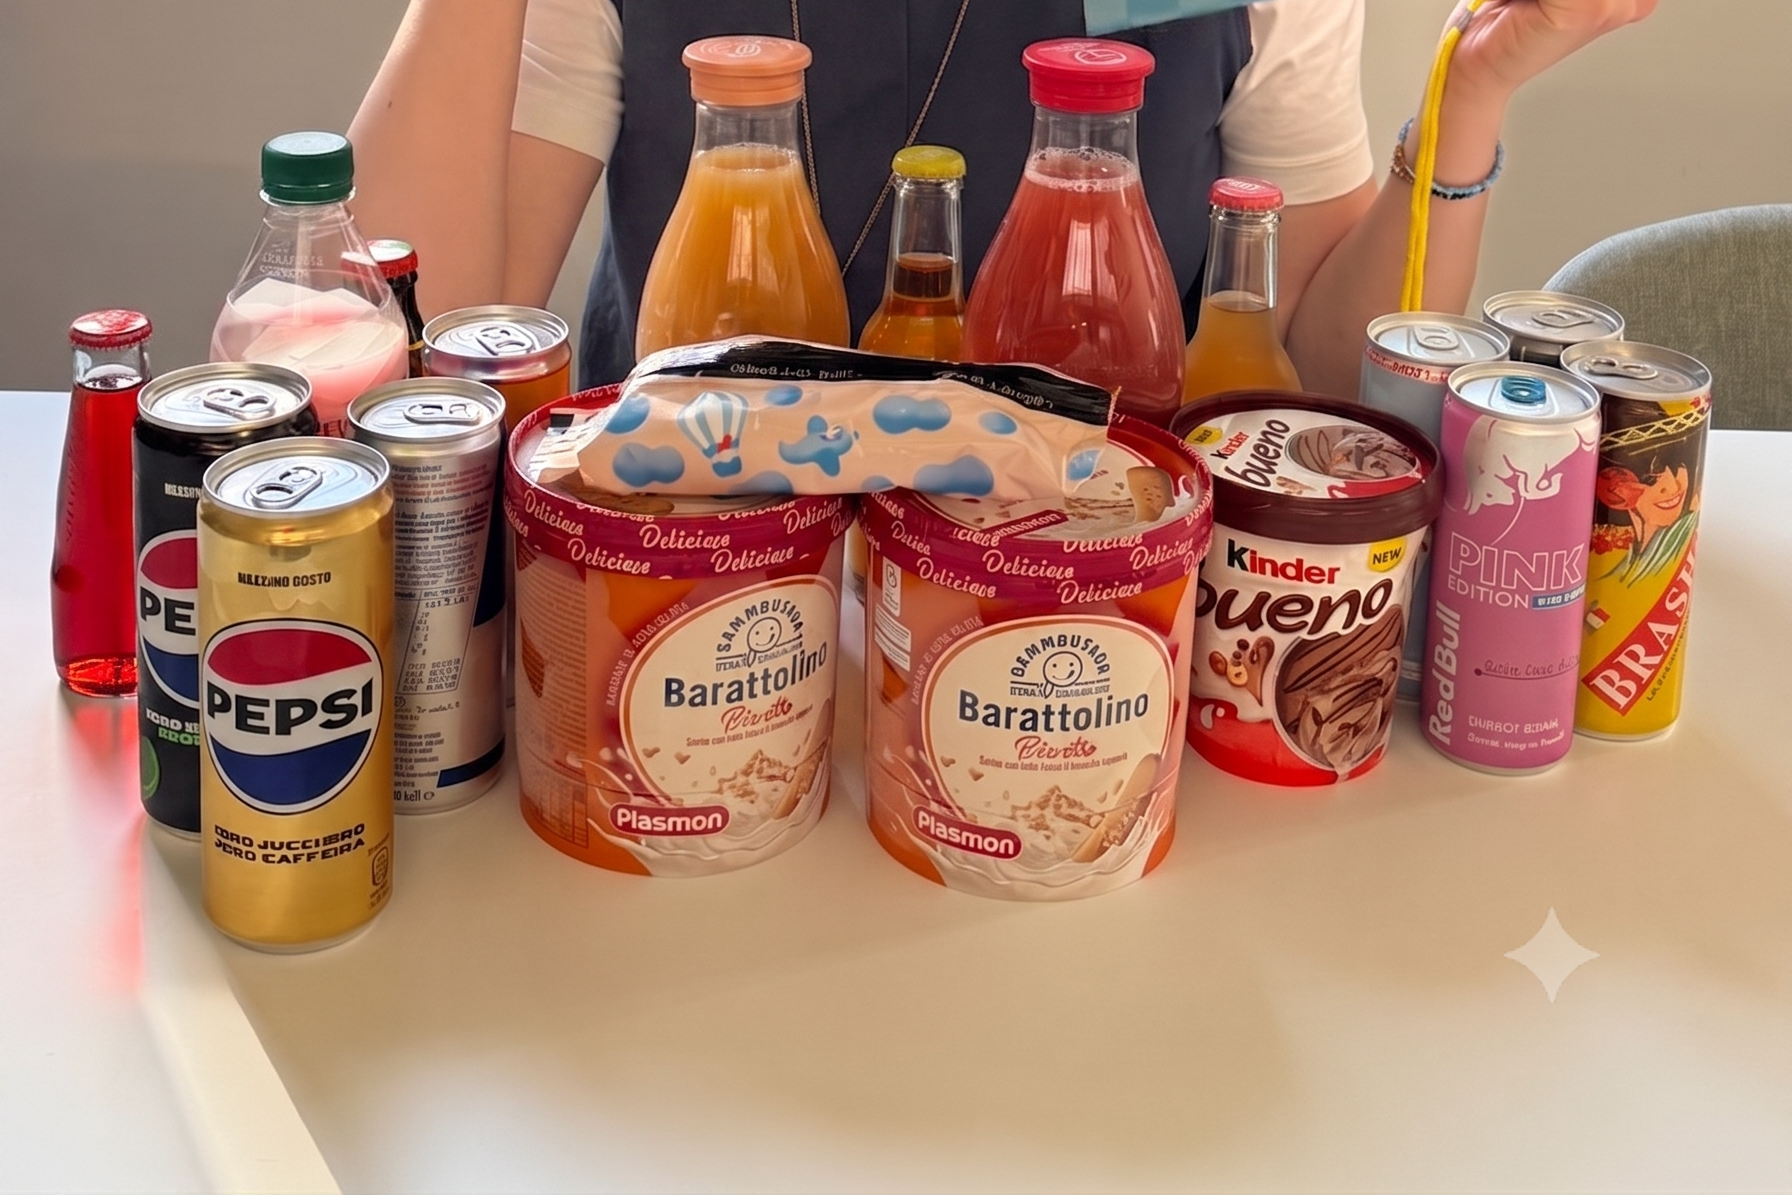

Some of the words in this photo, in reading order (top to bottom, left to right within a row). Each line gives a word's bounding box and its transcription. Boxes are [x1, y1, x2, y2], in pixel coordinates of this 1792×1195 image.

[1224, 419, 1290, 488] bueno
[1227, 539, 1340, 584] Kinder
[1373, 547, 1402, 565] NEW
[1450, 532, 1585, 591] PINK
[293, 572, 331, 587] GOSTO
[1448, 575, 1529, 609] EDITION
[664, 642, 828, 707] Barattolino
[207, 677, 373, 736] PEPSI
[959, 690, 1149, 733] Barattolino
[616, 808, 722, 832] Plasmon
[918, 812, 1015, 855] Plasmon
